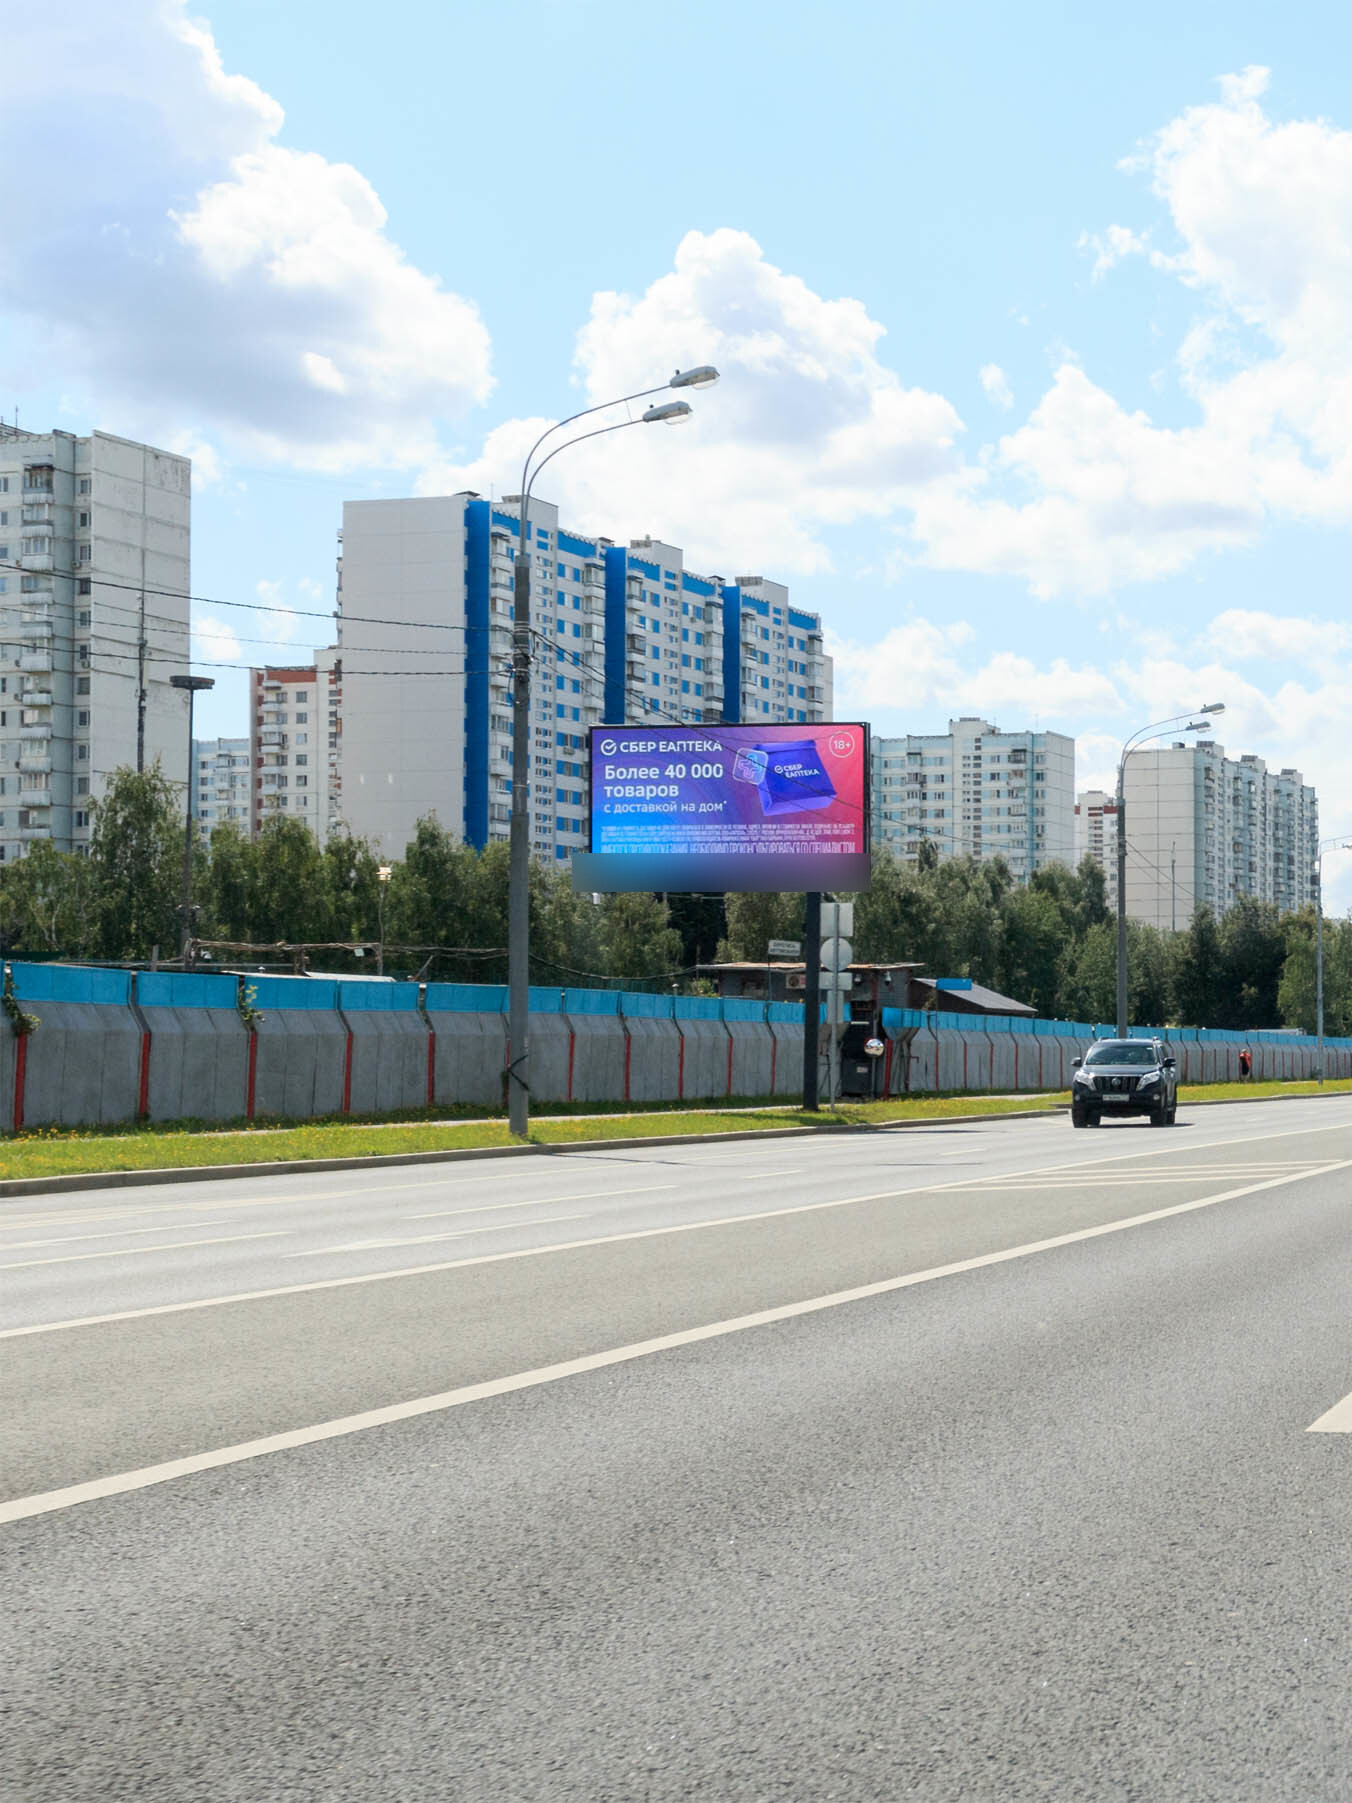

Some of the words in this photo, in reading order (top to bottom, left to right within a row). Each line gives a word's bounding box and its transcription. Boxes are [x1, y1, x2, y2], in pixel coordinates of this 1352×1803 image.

[620, 741, 656, 753] СБЕР
[659, 740, 723, 752] ЕАПТЕКА
[833, 741, 851, 750] 18+
[605, 765, 660, 780] Более
[665, 764, 686, 779] 40
[691, 763, 723, 778] 000
[604, 785, 679, 800] товаров
[604, 804, 611, 813] с
[614, 801, 677, 814] доставкой
[681, 803, 695, 812] на
